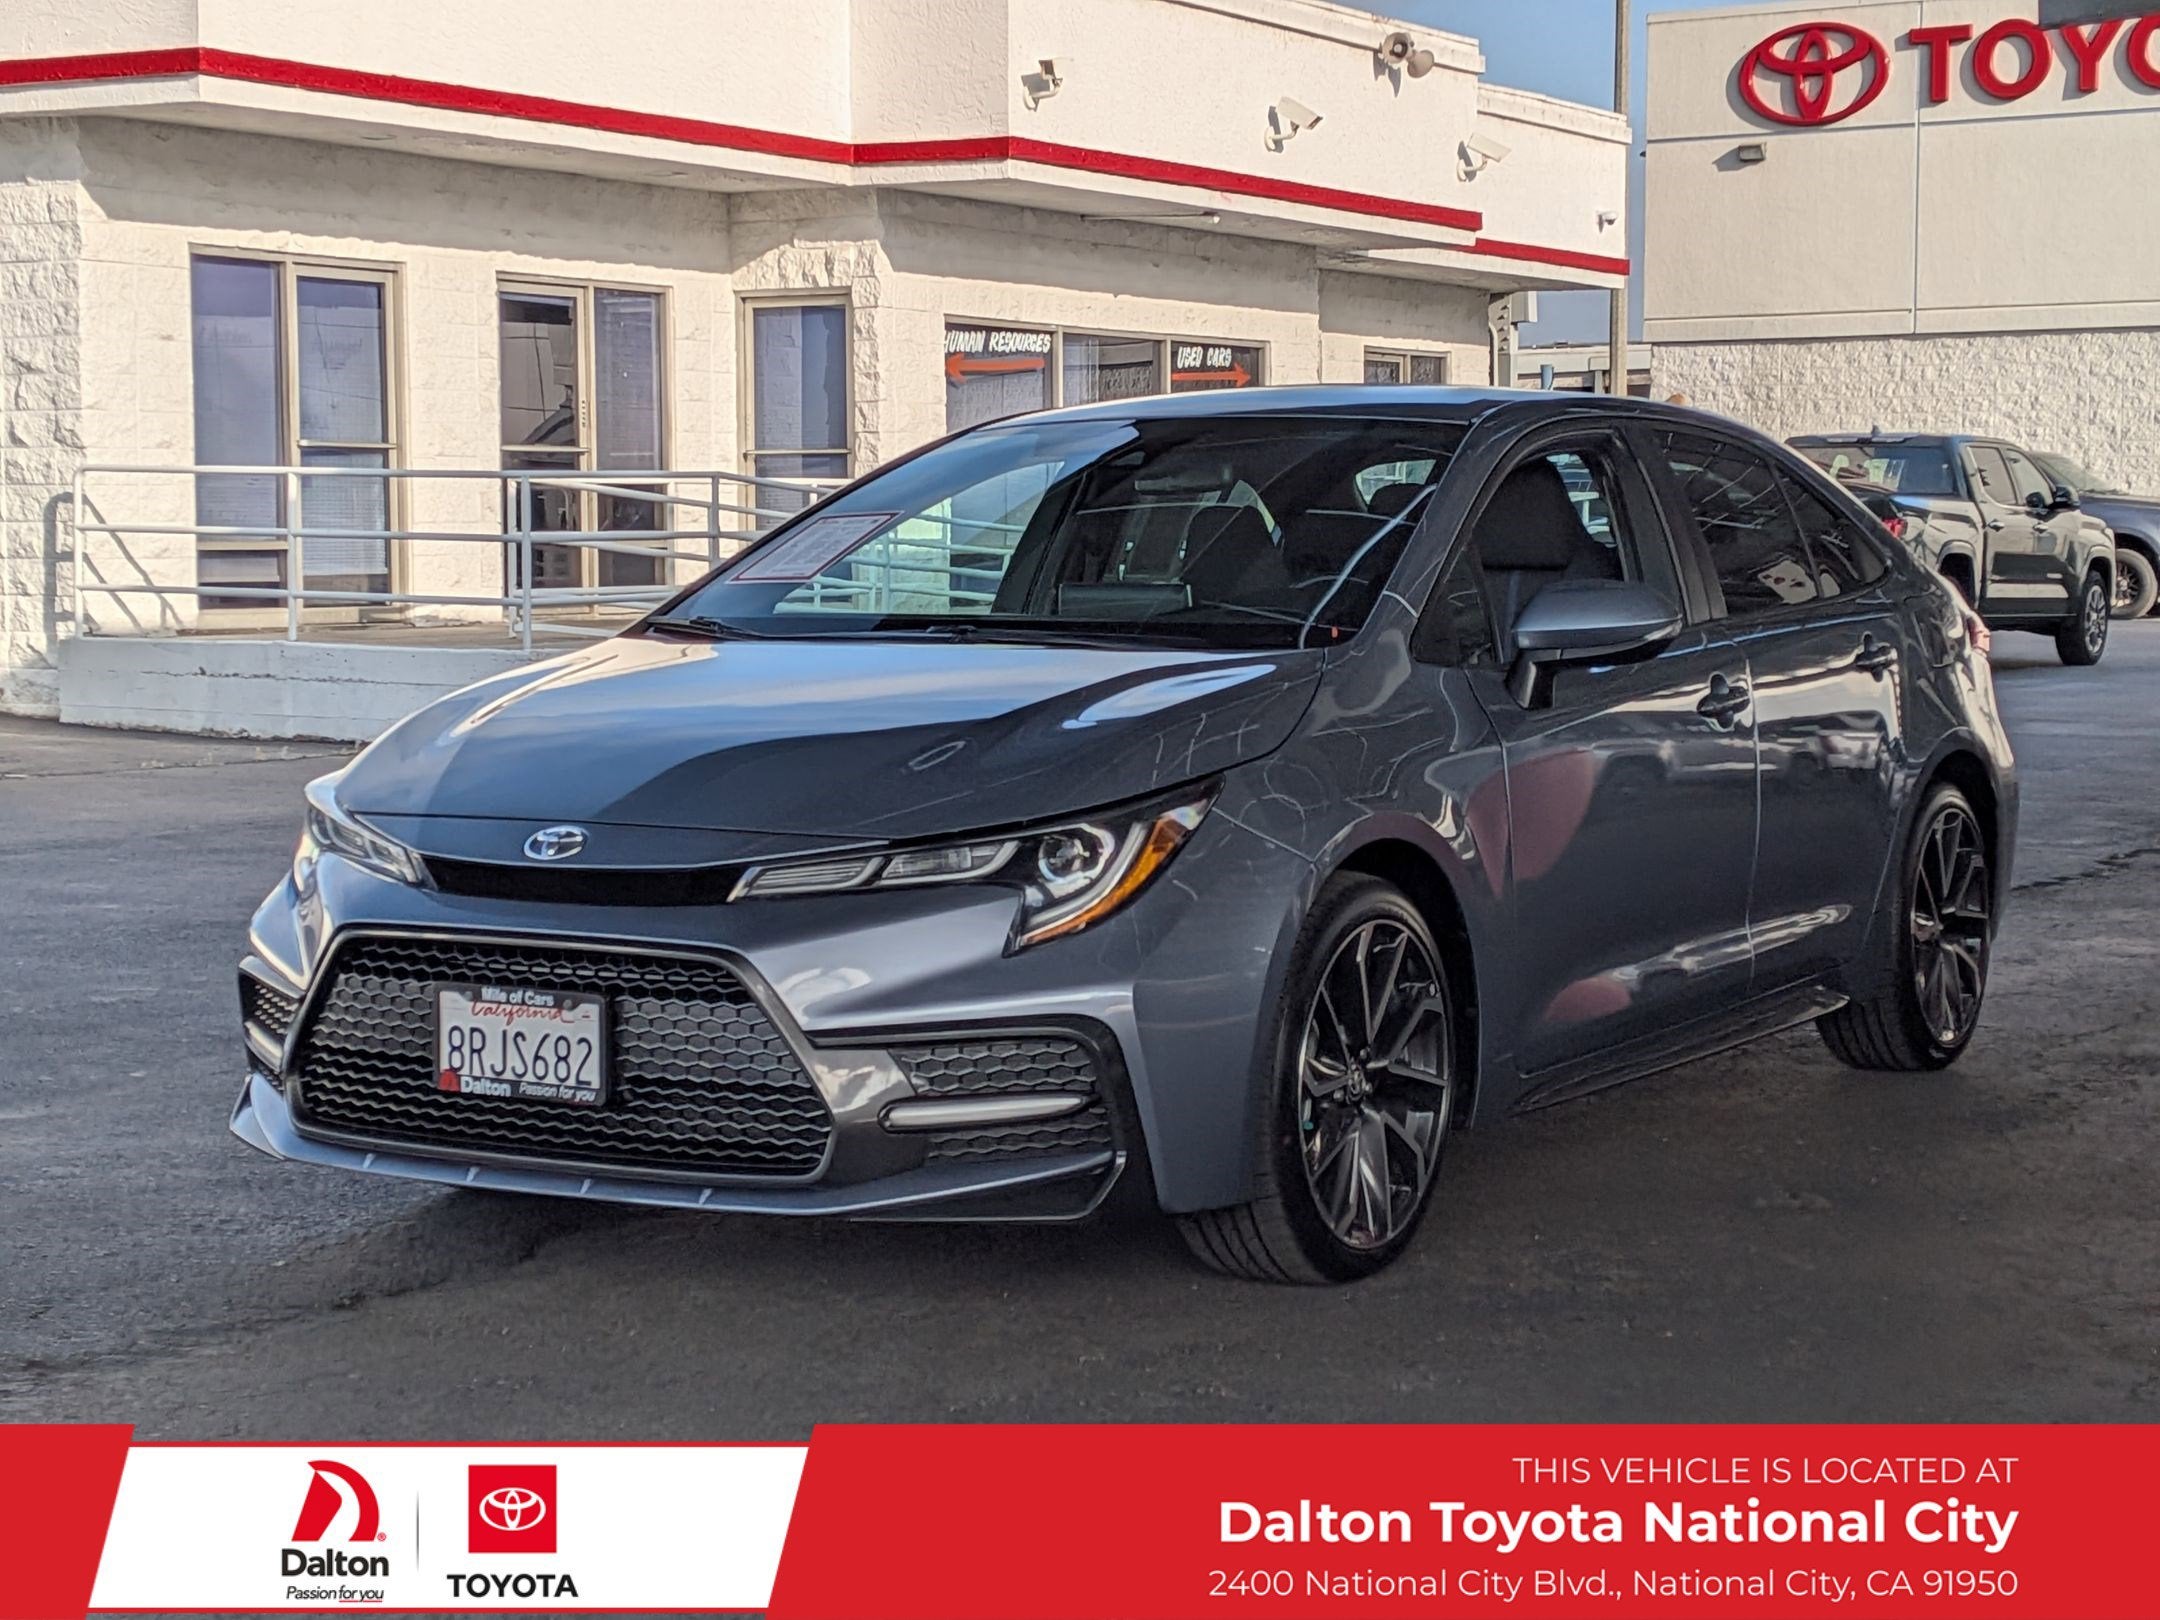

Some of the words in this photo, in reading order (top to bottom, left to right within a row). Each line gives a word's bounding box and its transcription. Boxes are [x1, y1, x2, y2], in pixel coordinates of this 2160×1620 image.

[944, 330, 986, 353] HUMAN
[989, 331, 1052, 353] RESOURCES
[1177, 346, 1204, 369] USED
[1206, 347, 1232, 368] CARS
[481, 986, 507, 1002] Mile
[509, 989, 523, 1004] of
[524, 991, 555, 1007] Cars
[471, 1001, 575, 1026] California
[448, 1025, 593, 1086] 8RJS682
[460, 1076, 512, 1097] Dalton
[519, 1082, 558, 1097] Passion
[557, 1084, 574, 1098] for
[573, 1090, 597, 1102] you
